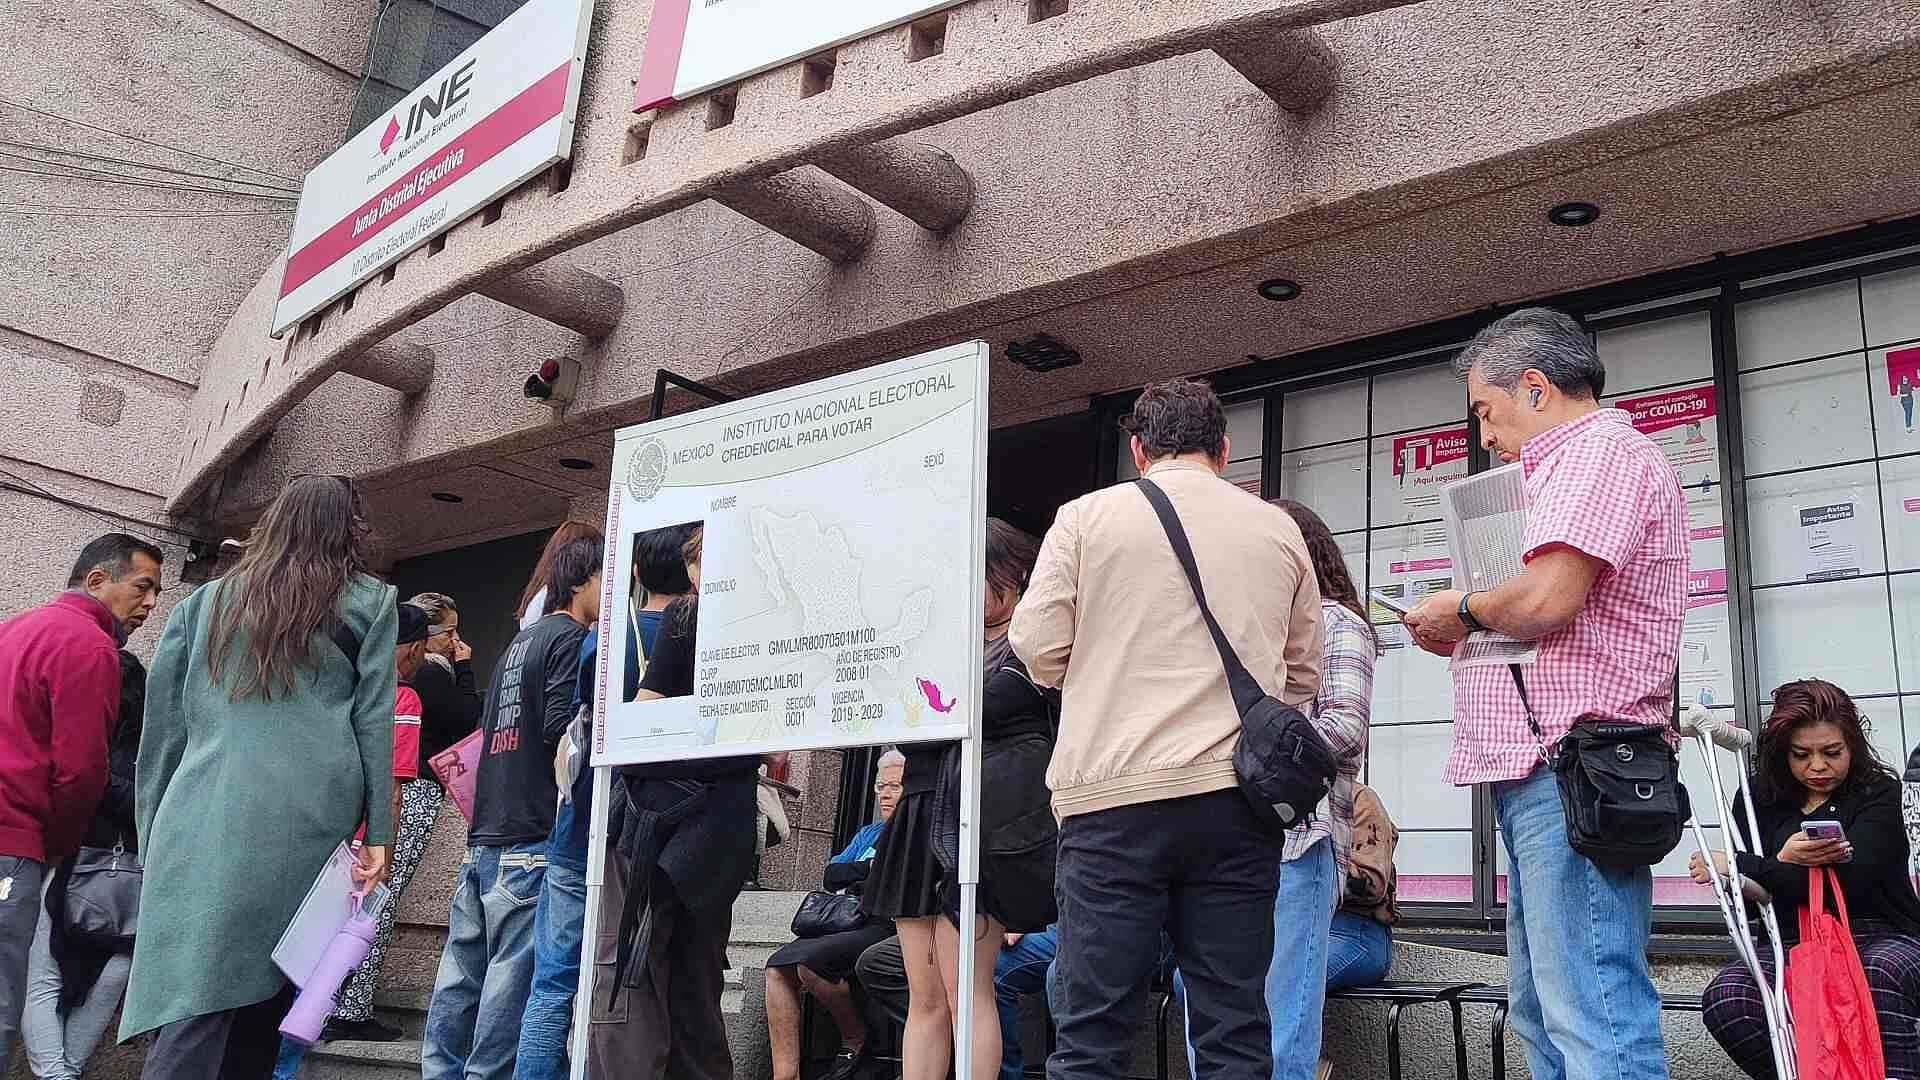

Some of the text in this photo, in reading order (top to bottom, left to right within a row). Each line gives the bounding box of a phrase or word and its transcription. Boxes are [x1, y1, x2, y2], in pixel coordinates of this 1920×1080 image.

[405, 57, 477, 141] INE
[431, 102, 468, 136] Electoral
[351, 148, 464, 238] Junta Distrital Ejecutiva
[418, 201, 448, 233] Federal
[722, 372, 956, 442] INSTITUTO NACIONAL ELECTORAL
[1649, 398, 1707, 417] COVID-19!
[721, 417, 874, 463] CREDENCIAL PARA VOTAR
[1436, 436, 1467, 449] Aviso
[924, 451, 945, 468] SEXO
[1436, 447, 1468, 457] Importan
[1434, 472, 1468, 484] seguimo
[710, 495, 737, 513] NOMBRE
[1688, 576, 1710, 593] quí
[701, 643, 760, 663] CLAVE DE ELECTOR
[852, 650, 863, 664] DE
[863, 645, 901, 661] REGISTRO
[700, 667, 718, 681] CURP
[835, 664, 870, 682] 2008 01
[831, 689, 865, 706] VIGENCIA
[494, 704, 521, 731] JUMP
[699, 698, 769, 718] FECHA DE NACIMIENTO
[831, 705, 853, 723] 2019
[861, 703, 883, 720] 2029
[785, 710, 805, 727] 0001
[490, 727, 519, 754] DISH
